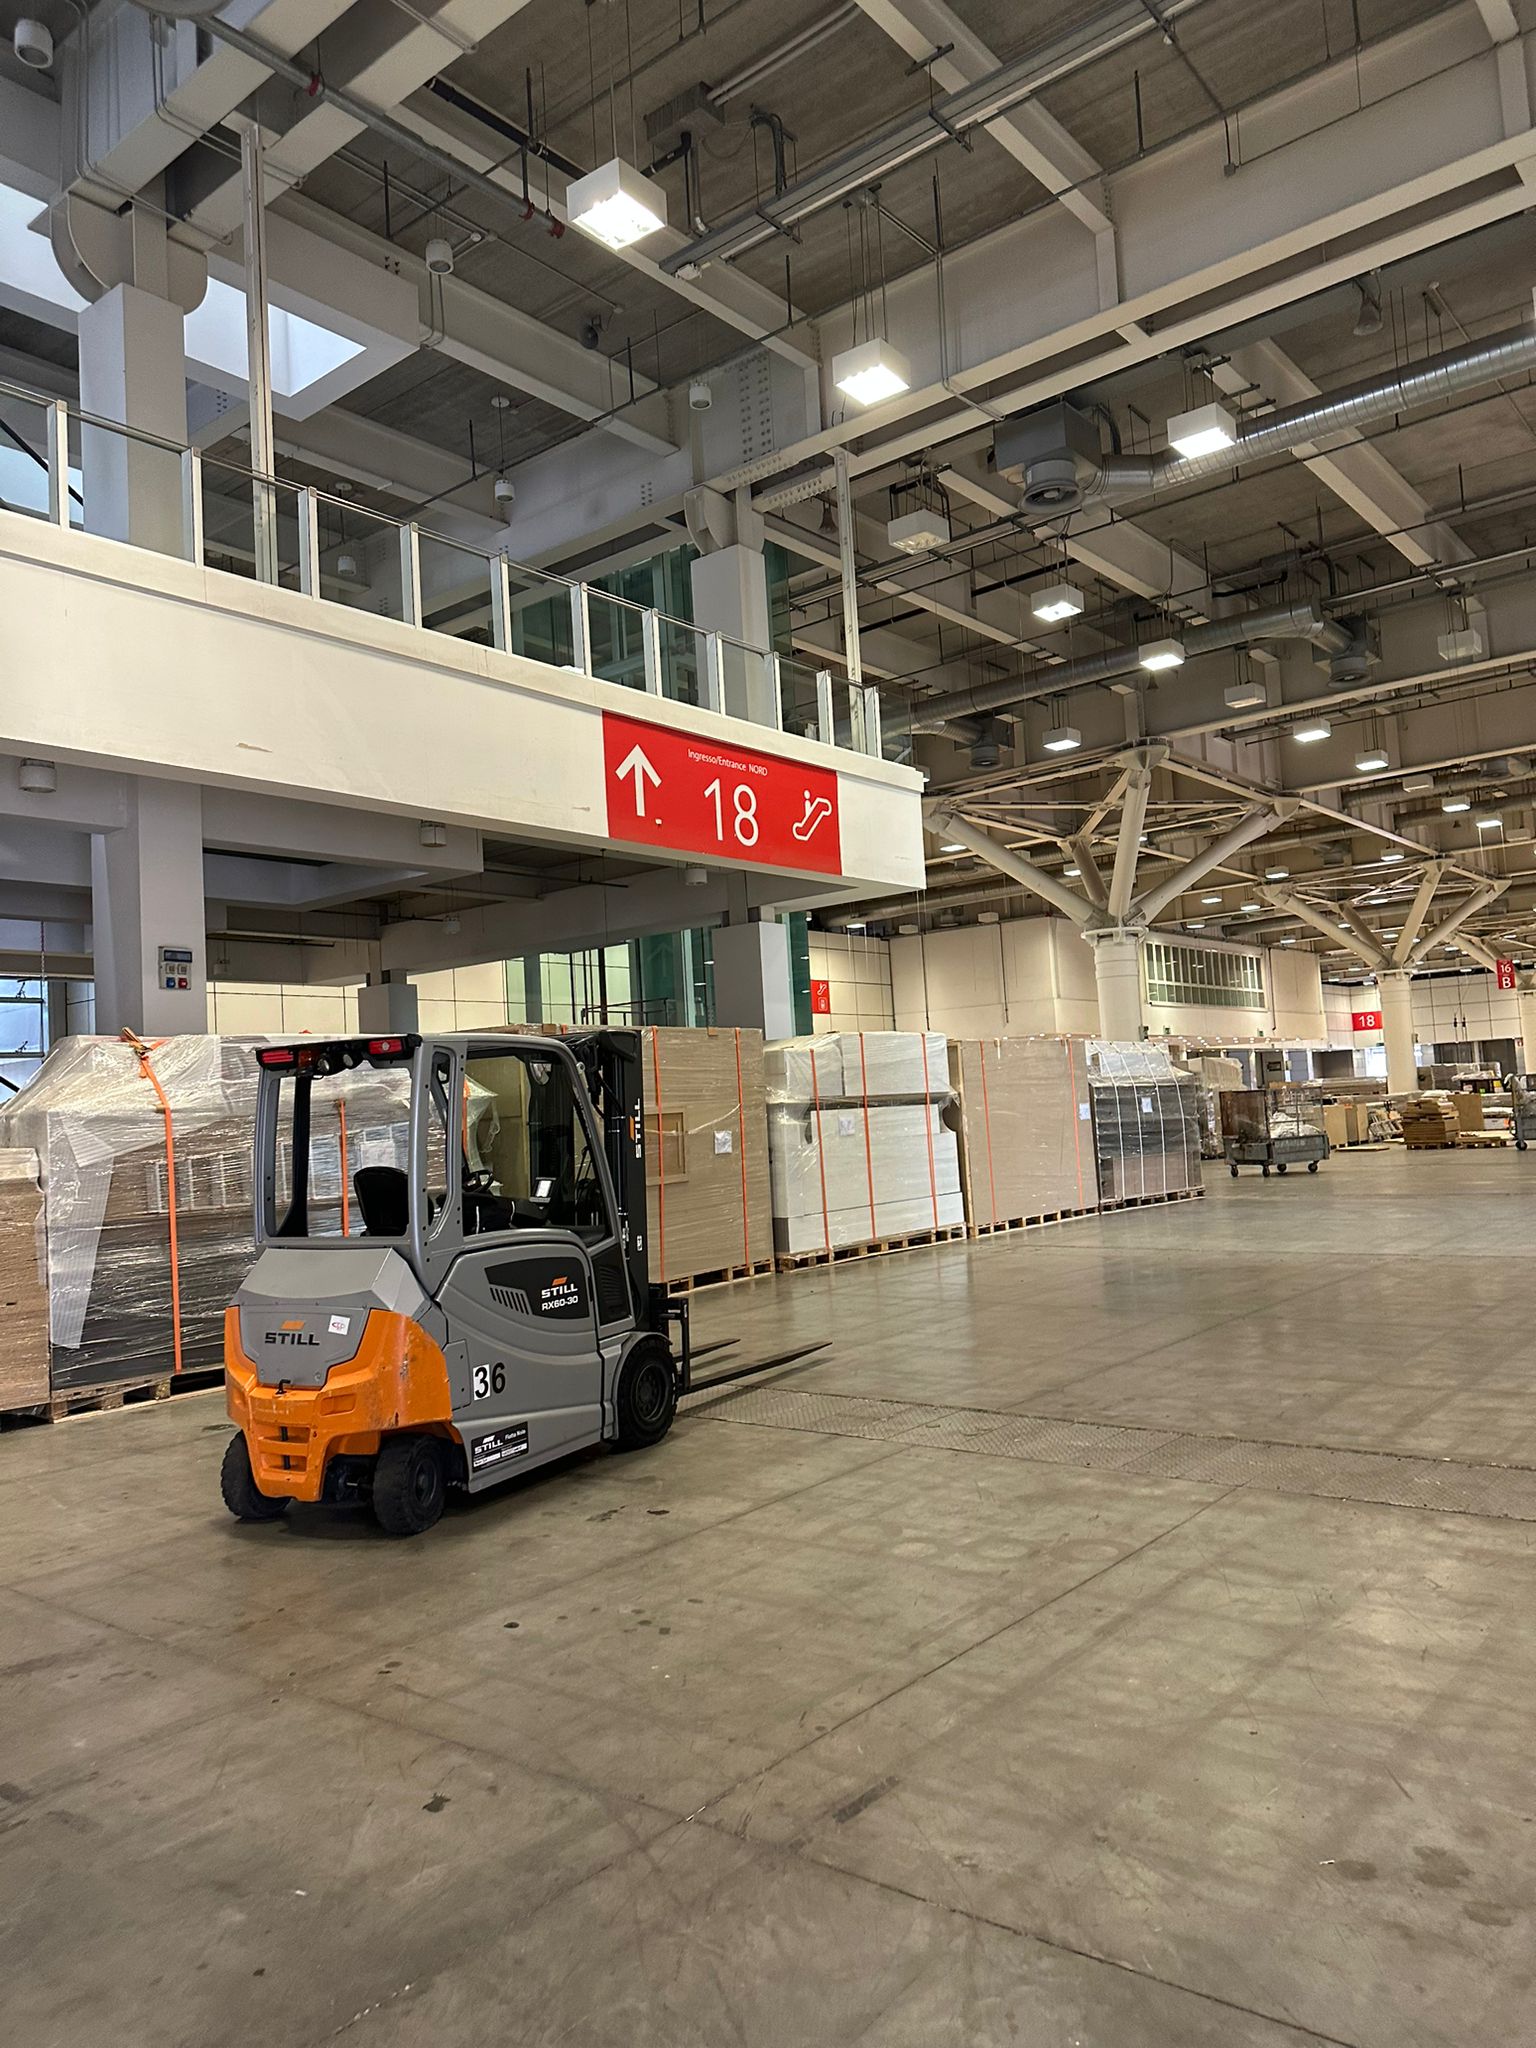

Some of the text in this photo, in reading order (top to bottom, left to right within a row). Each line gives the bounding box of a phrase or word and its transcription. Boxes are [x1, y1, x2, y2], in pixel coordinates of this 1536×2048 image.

[688, 749, 768, 777] Ingresso/Entrance NORD
[703, 778, 759, 847] 18
[1500, 964, 1512, 973] 16
[1502, 976, 1511, 988] B
[1358, 1015, 1376, 1027] 18
[541, 1283, 578, 1299] STILL
[541, 1295, 579, 1311] RX60-30
[264, 1332, 320, 1346] STILL
[474, 1362, 506, 1398] 36
[475, 1440, 503, 1454] STILL
